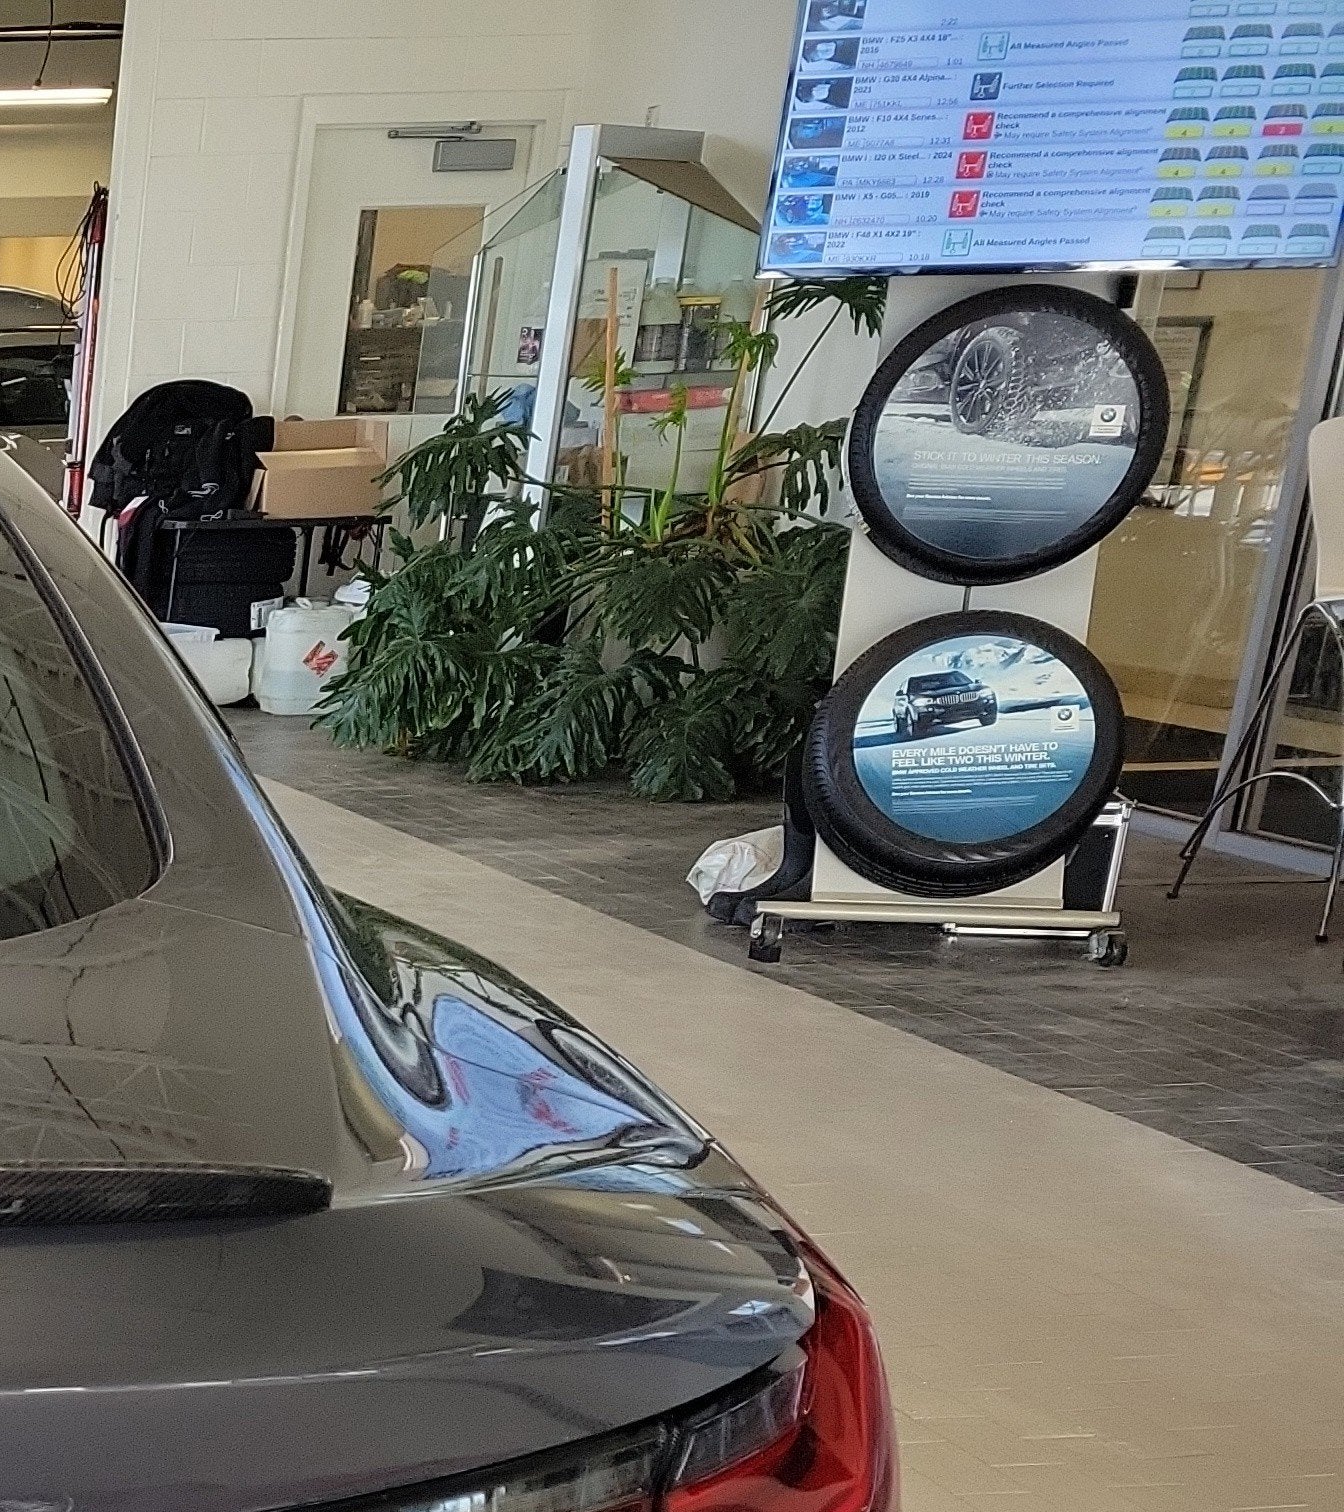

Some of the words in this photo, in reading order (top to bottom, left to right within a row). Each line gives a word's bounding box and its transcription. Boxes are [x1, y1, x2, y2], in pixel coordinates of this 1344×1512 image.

[1023, 41, 1064, 50] Measured
[1066, 40, 1096, 49] Angles
[997, 112, 1050, 120] Recommend
[990, 151, 1042, 159] Recommend
[982, 190, 1034, 198] Recommend
[1043, 188, 1107, 198] comprehensive
[1109, 187, 1151, 196] alignment
[981, 200, 1005, 208] check
[974, 238, 985, 246] All
[987, 238, 1027, 246] Measured
[1029, 237, 1057, 246] Angles
[1060, 236, 1090, 244] Passed
[914, 451, 945, 461] STICK
[962, 452, 977, 462] TO
[979, 452, 1022, 464] WINTER
[1026, 454, 1050, 464] THIS
[892, 750, 927, 758] EVERY
[930, 748, 956, 756] MILE
[959, 745, 1007, 756] DOESN'T
[1010, 743, 1039, 752] HAVE
[1042, 742, 1058, 751] TO
[892, 758, 918, 768] FEEL
[921, 756, 945, 766] LIKE
[949, 756, 974, 765] TWO
[976, 754, 1002, 764] THIS
[1004, 752, 1050, 762] WINTER.
